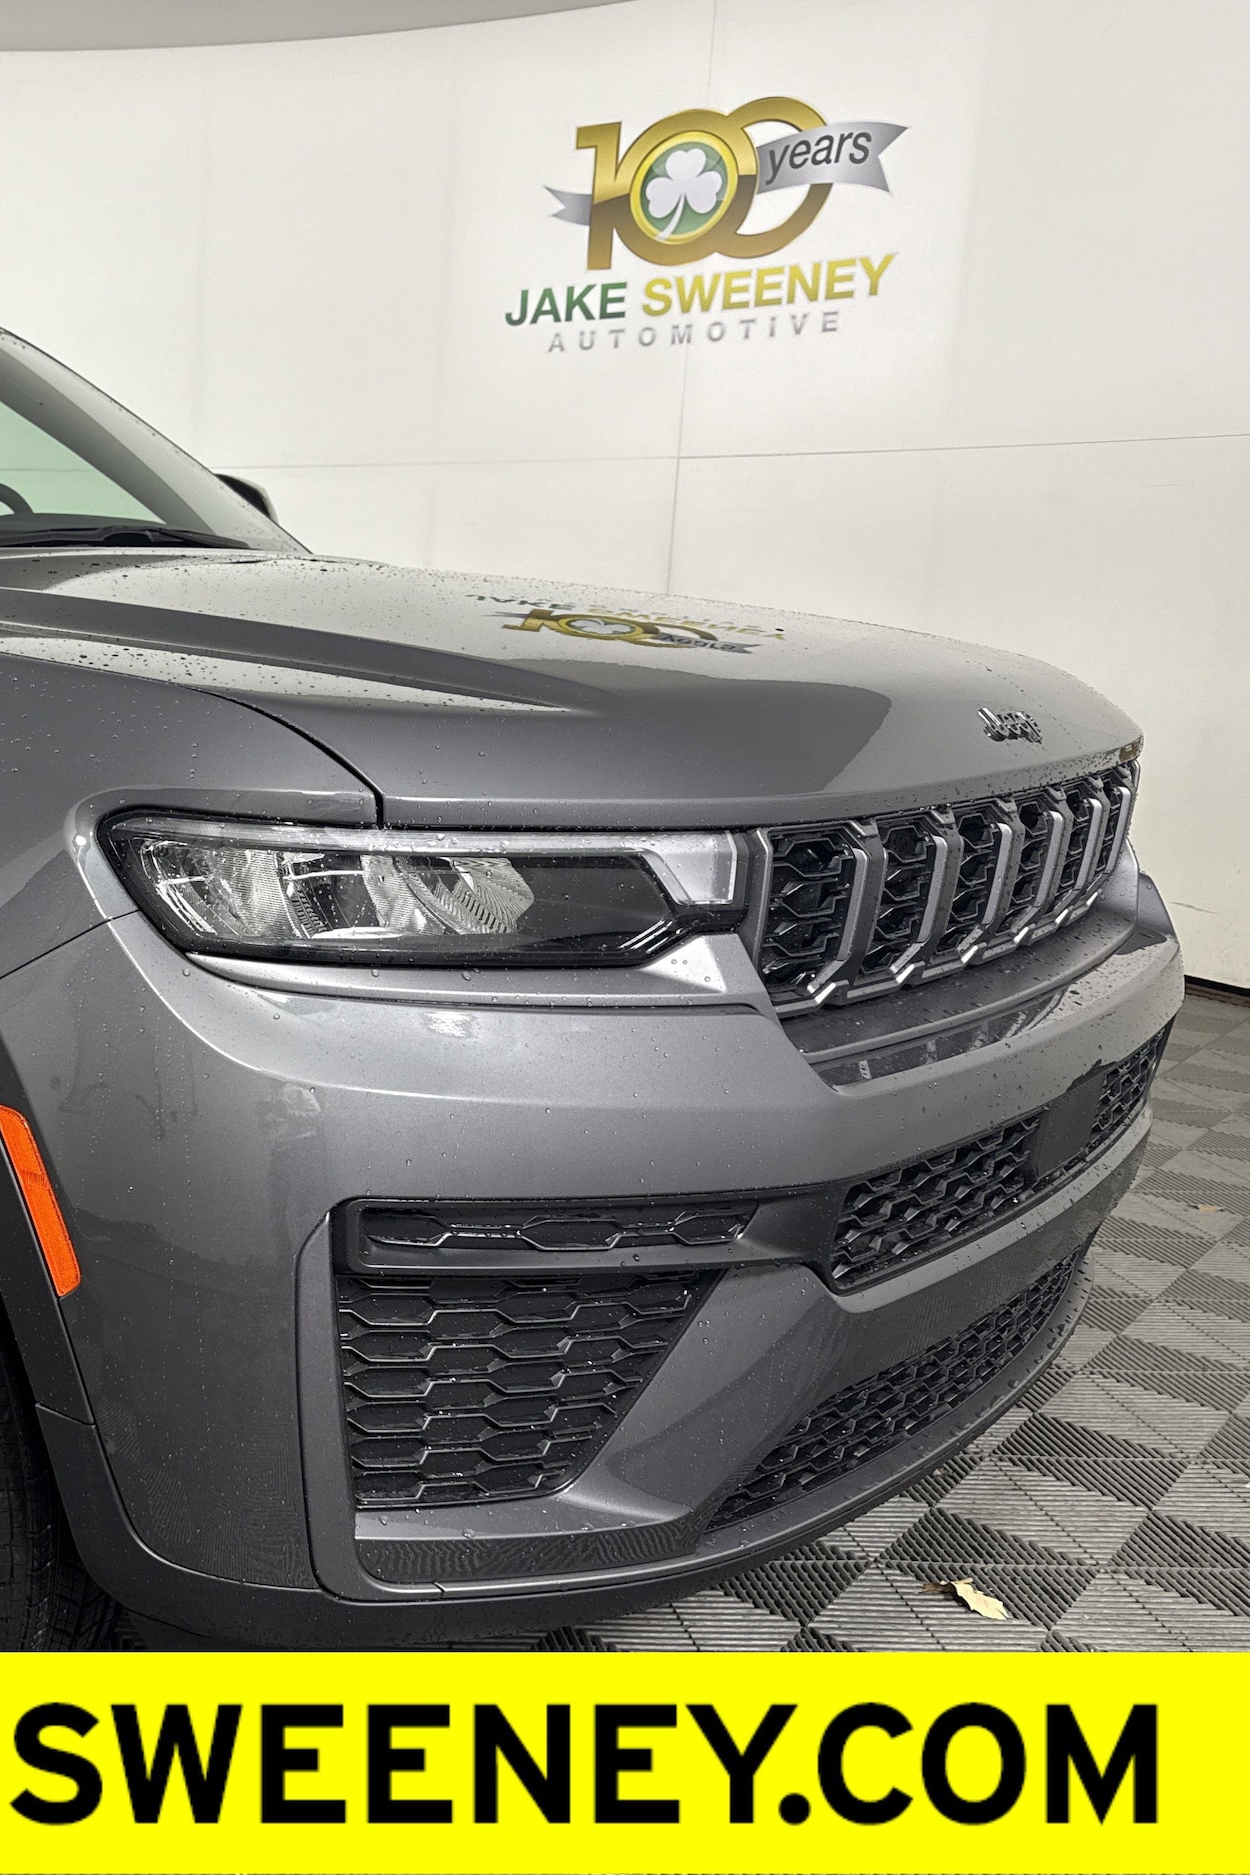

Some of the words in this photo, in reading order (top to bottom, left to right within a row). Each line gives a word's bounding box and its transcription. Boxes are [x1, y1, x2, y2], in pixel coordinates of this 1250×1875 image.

[765, 130, 872, 186] years
[505, 282, 628, 326] JAKE
[642, 254, 897, 317] SWEENEY
[547, 310, 840, 353] AUTOMOTIVE
[977, 707, 1043, 744] Jeep
